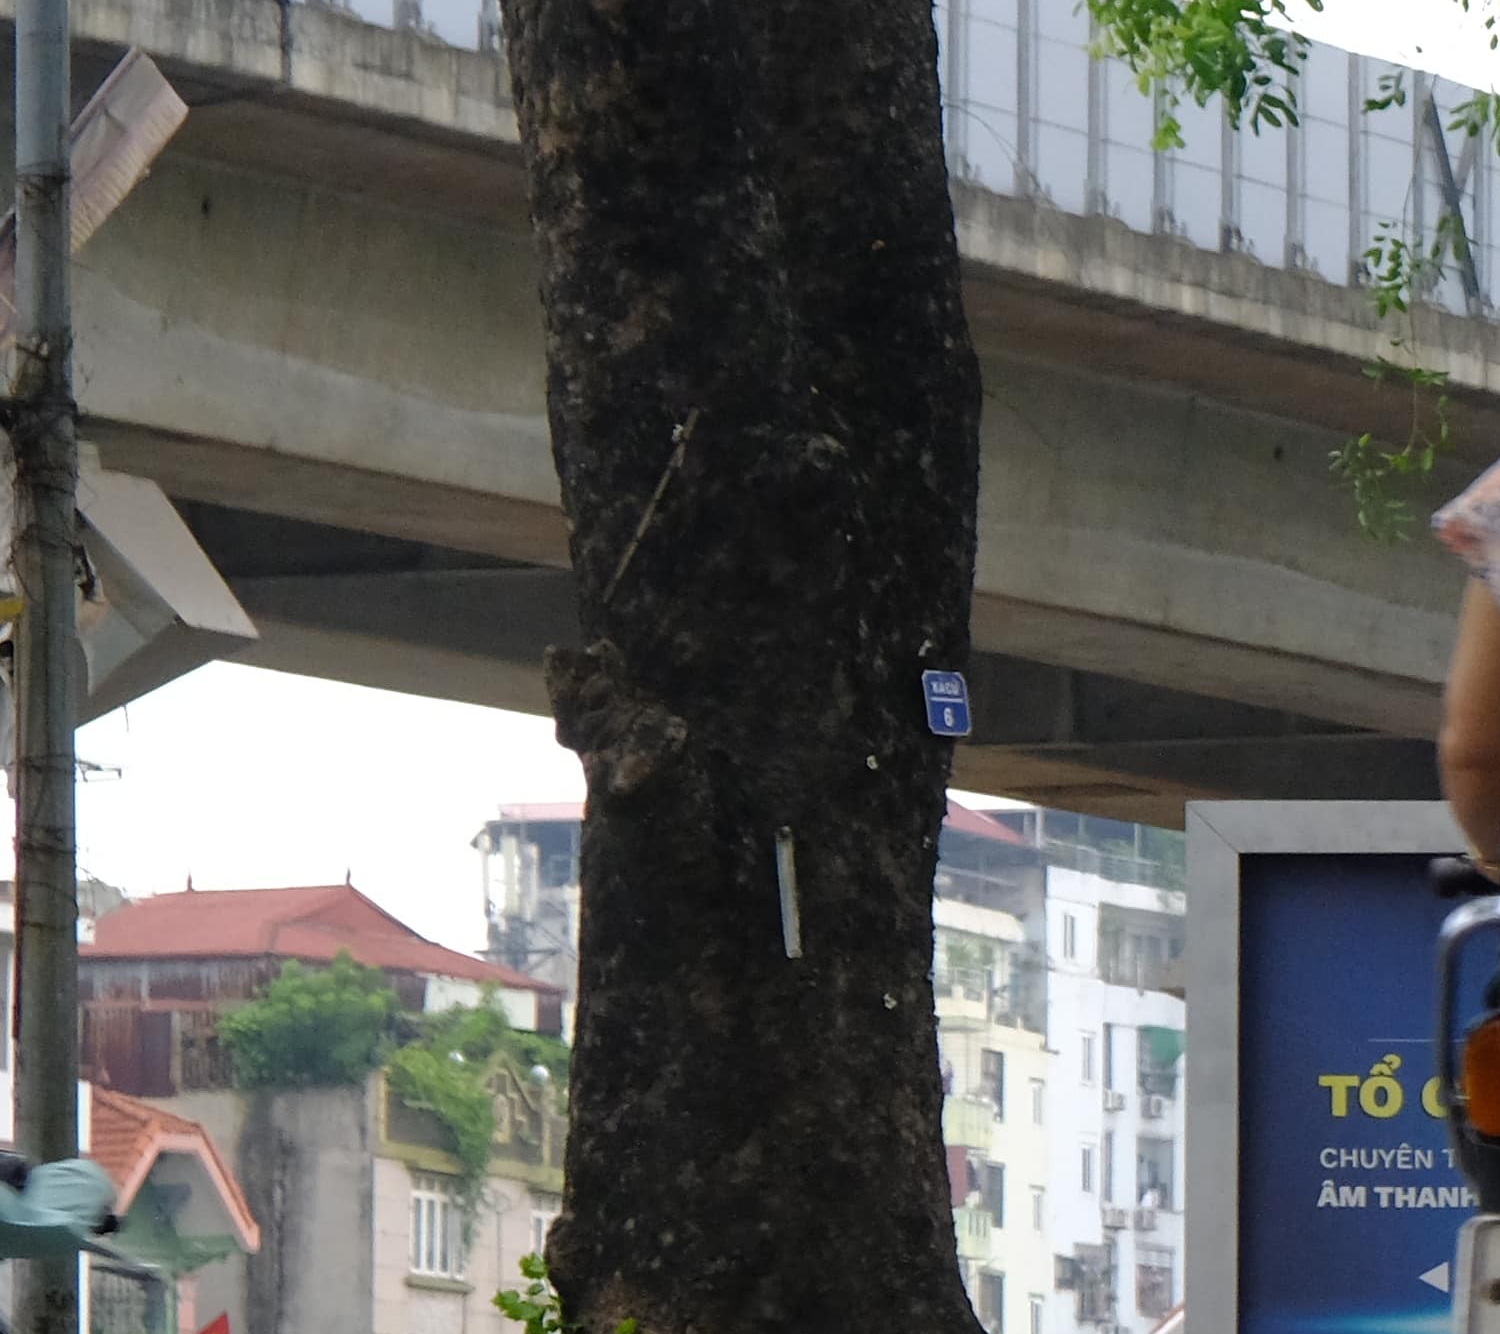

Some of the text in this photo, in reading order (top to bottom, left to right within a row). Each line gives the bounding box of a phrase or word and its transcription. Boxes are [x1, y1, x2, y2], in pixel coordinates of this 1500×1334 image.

[943, 707, 954, 727] 6
[1318, 1054, 1403, 1118] TỔ
[1319, 1142, 1433, 1169] CHUYÊN
[1317, 1179, 1367, 1208] ÂM
